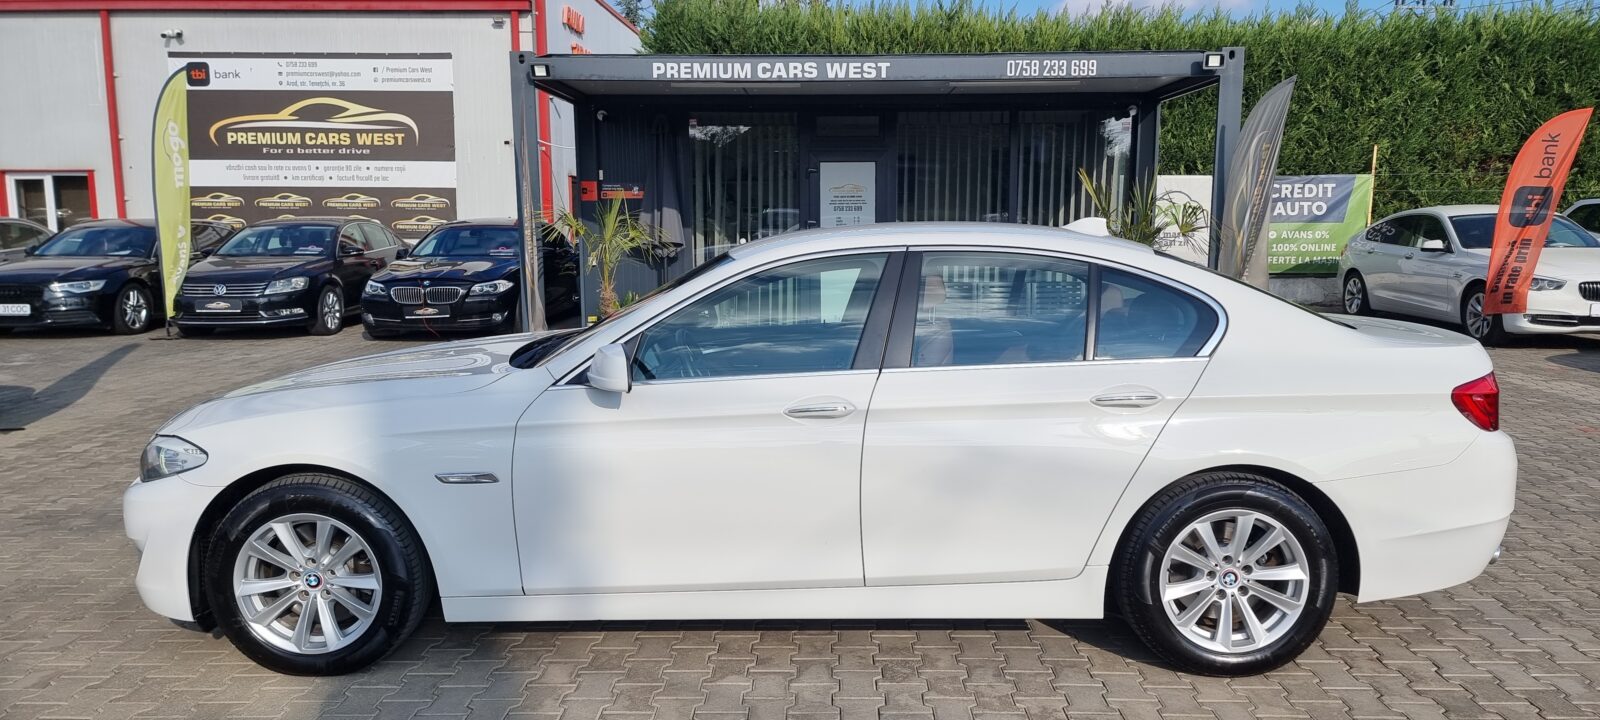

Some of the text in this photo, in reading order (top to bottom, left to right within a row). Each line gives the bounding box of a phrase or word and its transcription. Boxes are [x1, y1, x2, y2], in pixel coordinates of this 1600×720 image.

[190, 69, 241, 80] tbi bank
[652, 62, 891, 79] PREMIUM CARS WEST
[1006, 60, 1097, 76] 0758 233 699
[226, 132, 405, 146] PREMIUM CARS WEST
[167, 119, 185, 188] mogo
[338, 147, 371, 155] drive
[1533, 132, 1561, 178] bank
[1273, 201, 1328, 216] AUTO
[1281, 231, 1330, 239] AVANS 0%
[1271, 243, 1337, 252] 100% ONLINE
[1268, 256, 1297, 264] FERTE
[1298, 256, 1311, 264] LA
[1504, 265, 1523, 289] rate
